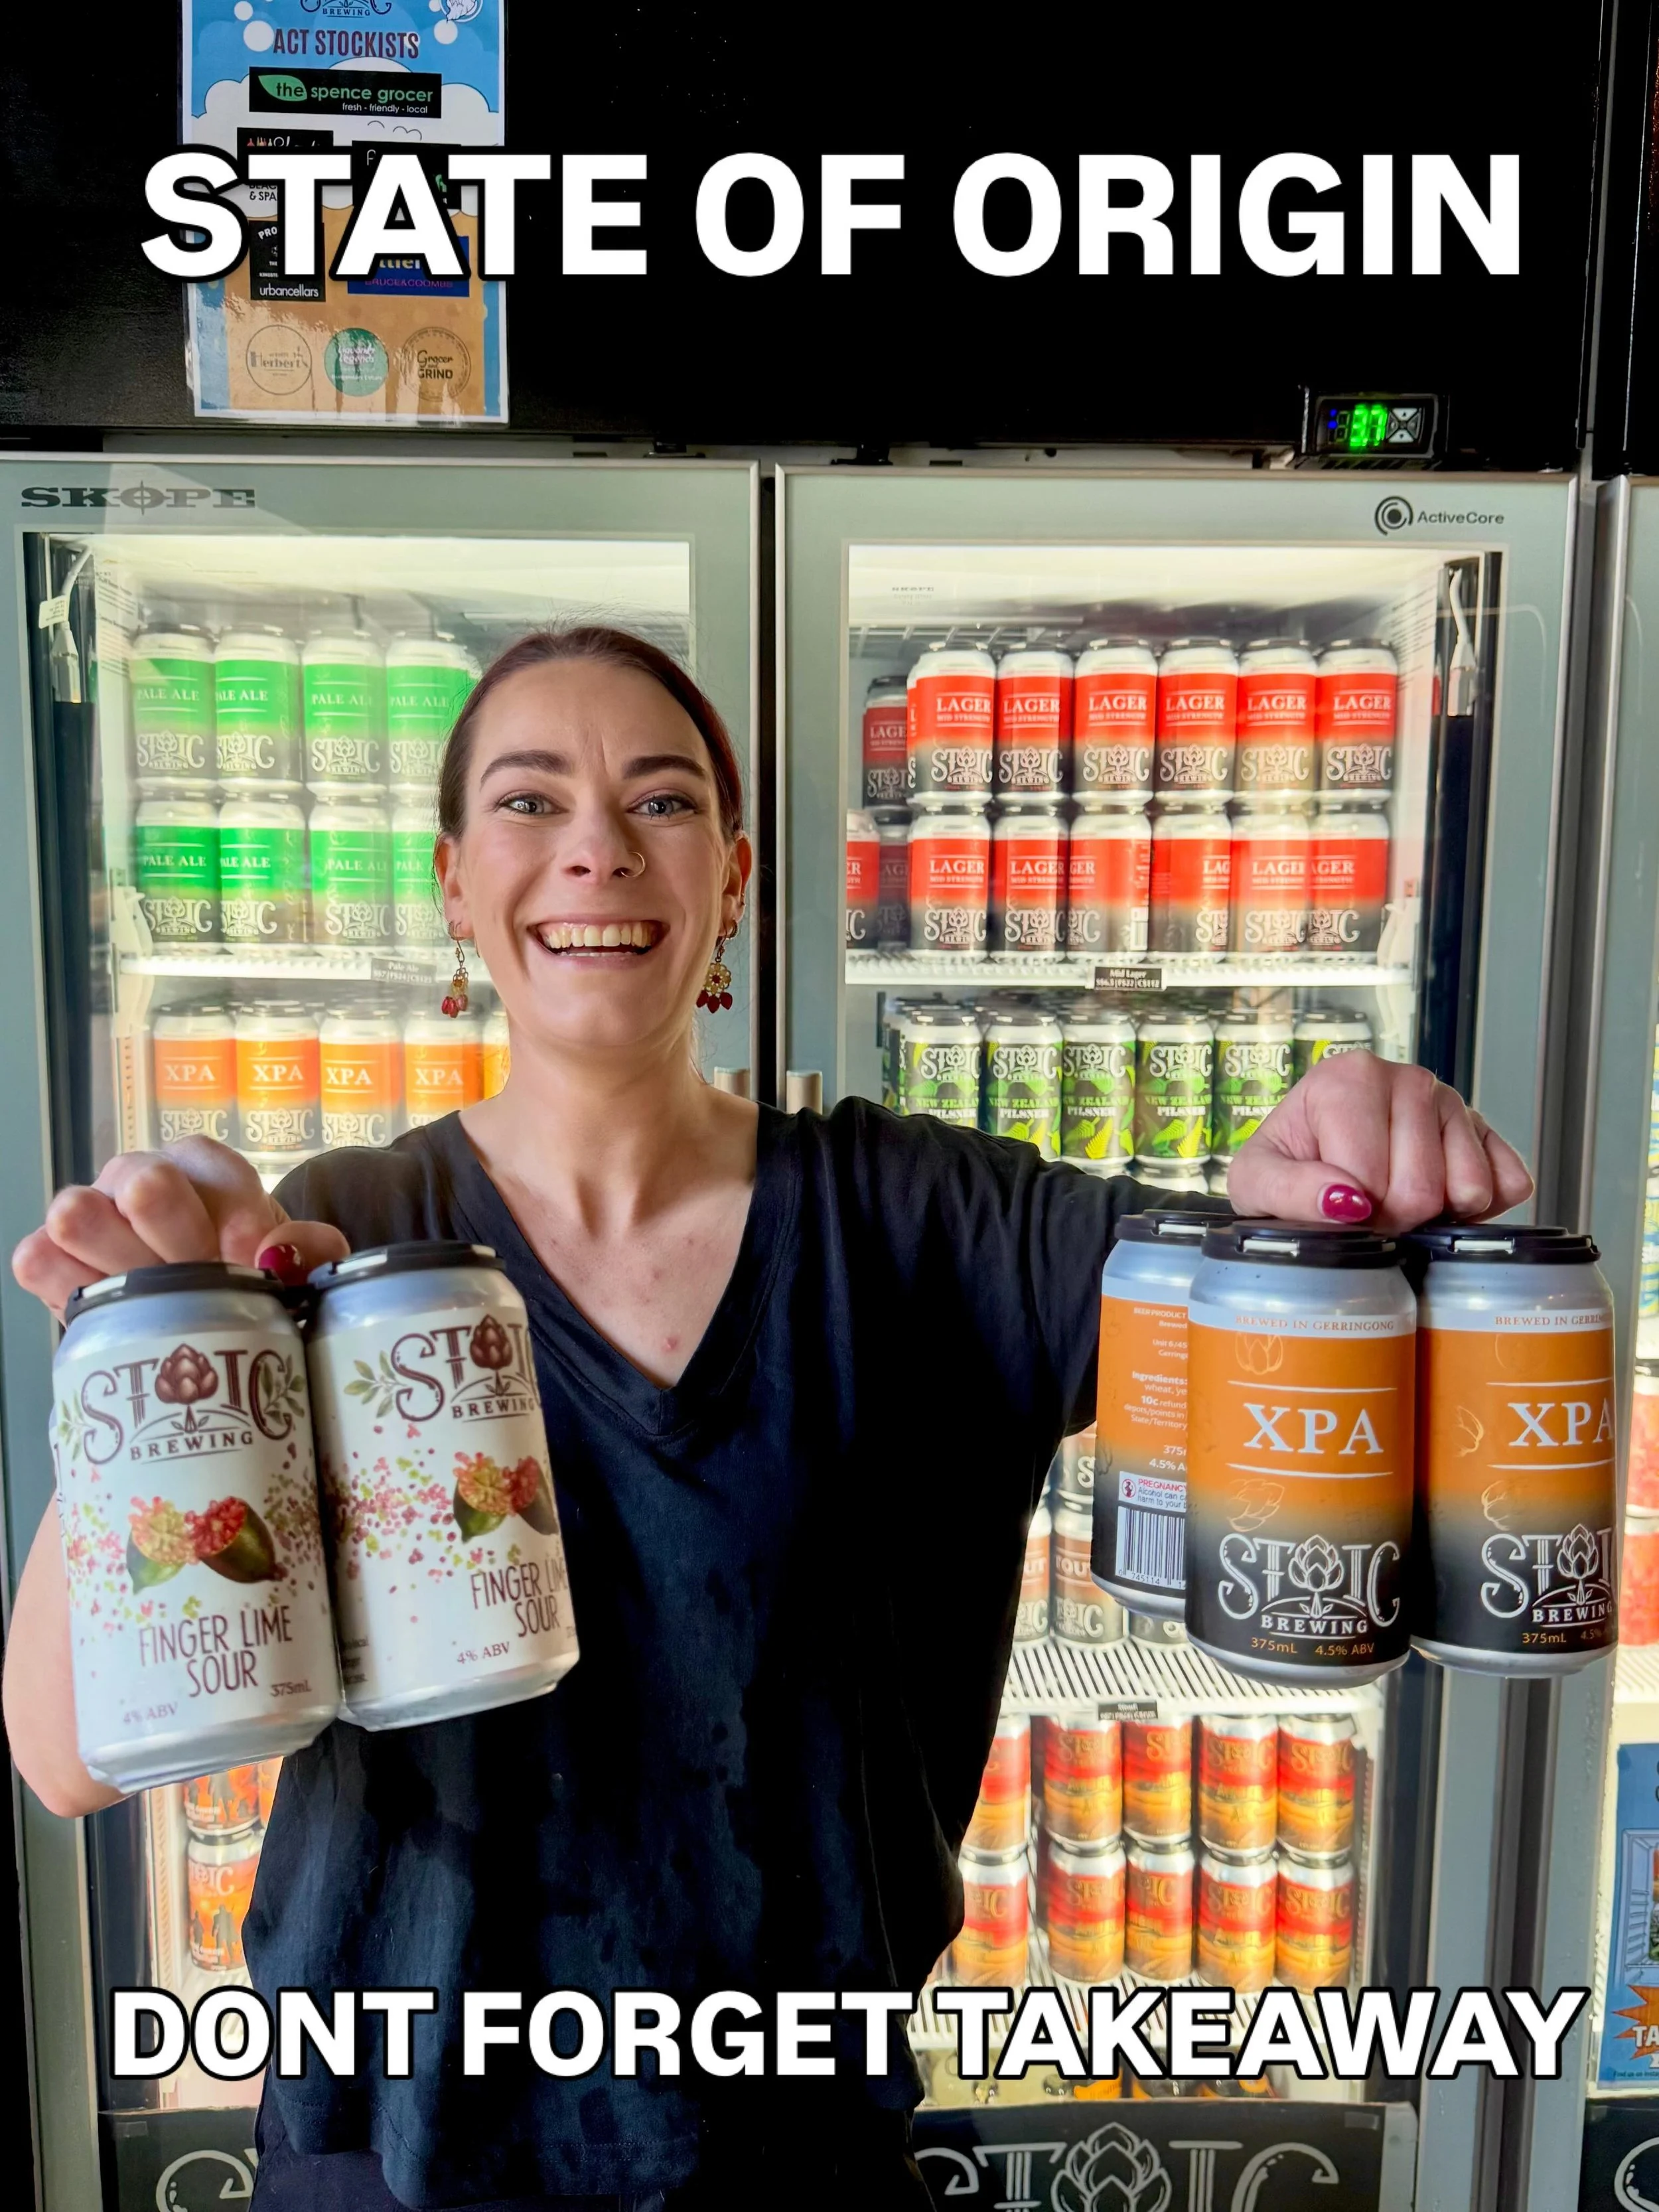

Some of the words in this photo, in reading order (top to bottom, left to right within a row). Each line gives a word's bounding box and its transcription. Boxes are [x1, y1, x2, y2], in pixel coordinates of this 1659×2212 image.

[323, 8, 370, 17] BREWING
[273, 28, 309, 54] ACT
[315, 29, 419, 58] STOCKISTS
[276, 82, 304, 98] the
[311, 86, 372, 101] spence
[377, 88, 433, 104] grocer
[342, 103, 362, 111] fresh
[369, 103, 399, 113] friendly
[406, 105, 428, 113] local
[259, 283, 319, 297] urbancellars
[417, 350, 453, 364] Grocer
[417, 369, 453, 379] GRIND
[21, 484, 255, 510] SKOPE
[1417, 510, 1504, 524] ActiveCore
[172, 689, 200, 701] ALE
[240, 689, 268, 701] ALE
[311, 694, 344, 705] PALE
[1166, 695, 1225, 711] LAGER
[1248, 695, 1307, 711] LAGER
[1334, 694, 1392, 711] LAGER
[936, 696, 991, 714] LAGER
[1003, 698, 1060, 715] LAGER
[1089, 695, 1147, 712] LAGER
[143, 855, 174, 867] PALE
[179, 855, 206, 867] ALE
[240, 857, 271, 868] ALE
[327, 860, 362, 871] PALE
[930, 859, 985, 875] LAGER
[1011, 860, 1064, 875] LAGER
[165, 1064, 216, 1082] XPA
[253, 1064, 303, 1082] XPA
[325, 1067, 372, 1085] XPA
[415, 1068, 463, 1086] XPA
[1151, 1309, 1187, 1319] PRODUCT
[1495, 1316, 1550, 1326] BREWED
[1555, 1316, 1568, 1325] IN
[1159, 1319, 1187, 1329] Brewed
[1235, 1315, 1288, 1328] BREWED
[1293, 1320, 1308, 1329] IN
[1313, 1320, 1394, 1331] GERRINGONG
[1153, 1339, 1167, 1347] Unit
[390, 1319, 541, 1422] STOI
[1132, 1370, 1188, 1385] Ingredients:
[1144, 1384, 1175, 1394] wheat,
[81, 1345, 293, 1465] STOIC
[451, 1396, 535, 1420] BREWING
[1141, 1395, 1159, 1406] 10c
[1160, 1400, 1187, 1410] refund
[1131, 1414, 1189, 1431] State/Territory
[1243, 1402, 1384, 1455] XPA
[1507, 1396, 1615, 1447] XPA
[129, 1431, 253, 1461] BREWING
[1149, 1458, 1177, 1470] 4.5%
[1137, 1495, 1155, 1505] harm
[1138, 1487, 1163, 1498] Alcohol
[1164, 1493, 1178, 1501] can
[471, 1562, 542, 1610] FINGER
[1131, 1572, 1160, 1585] 745114
[1218, 1533, 1400, 1627] STOIC
[514, 1595, 561, 1638] SOUR
[1532, 1601, 1613, 1623] BREWING
[1262, 1614, 1368, 1635] BREWING
[139, 1614, 229, 1666] FINGER
[240, 1605, 293, 1648] LIME
[1522, 1633, 1567, 1644] 375mL
[457, 1651, 478, 1664] 4%
[482, 1641, 510, 1659] ABV
[1251, 1637, 1298, 1653] 375mL
[1315, 1644, 1348, 1656] 4.5%
[1351, 1642, 1374, 1655] ABV
[186, 1650, 259, 1698] SOUR
[269, 1680, 312, 1697] 375mL
[123, 1710, 142, 1726] 4%
[147, 1703, 179, 1720] ABV
